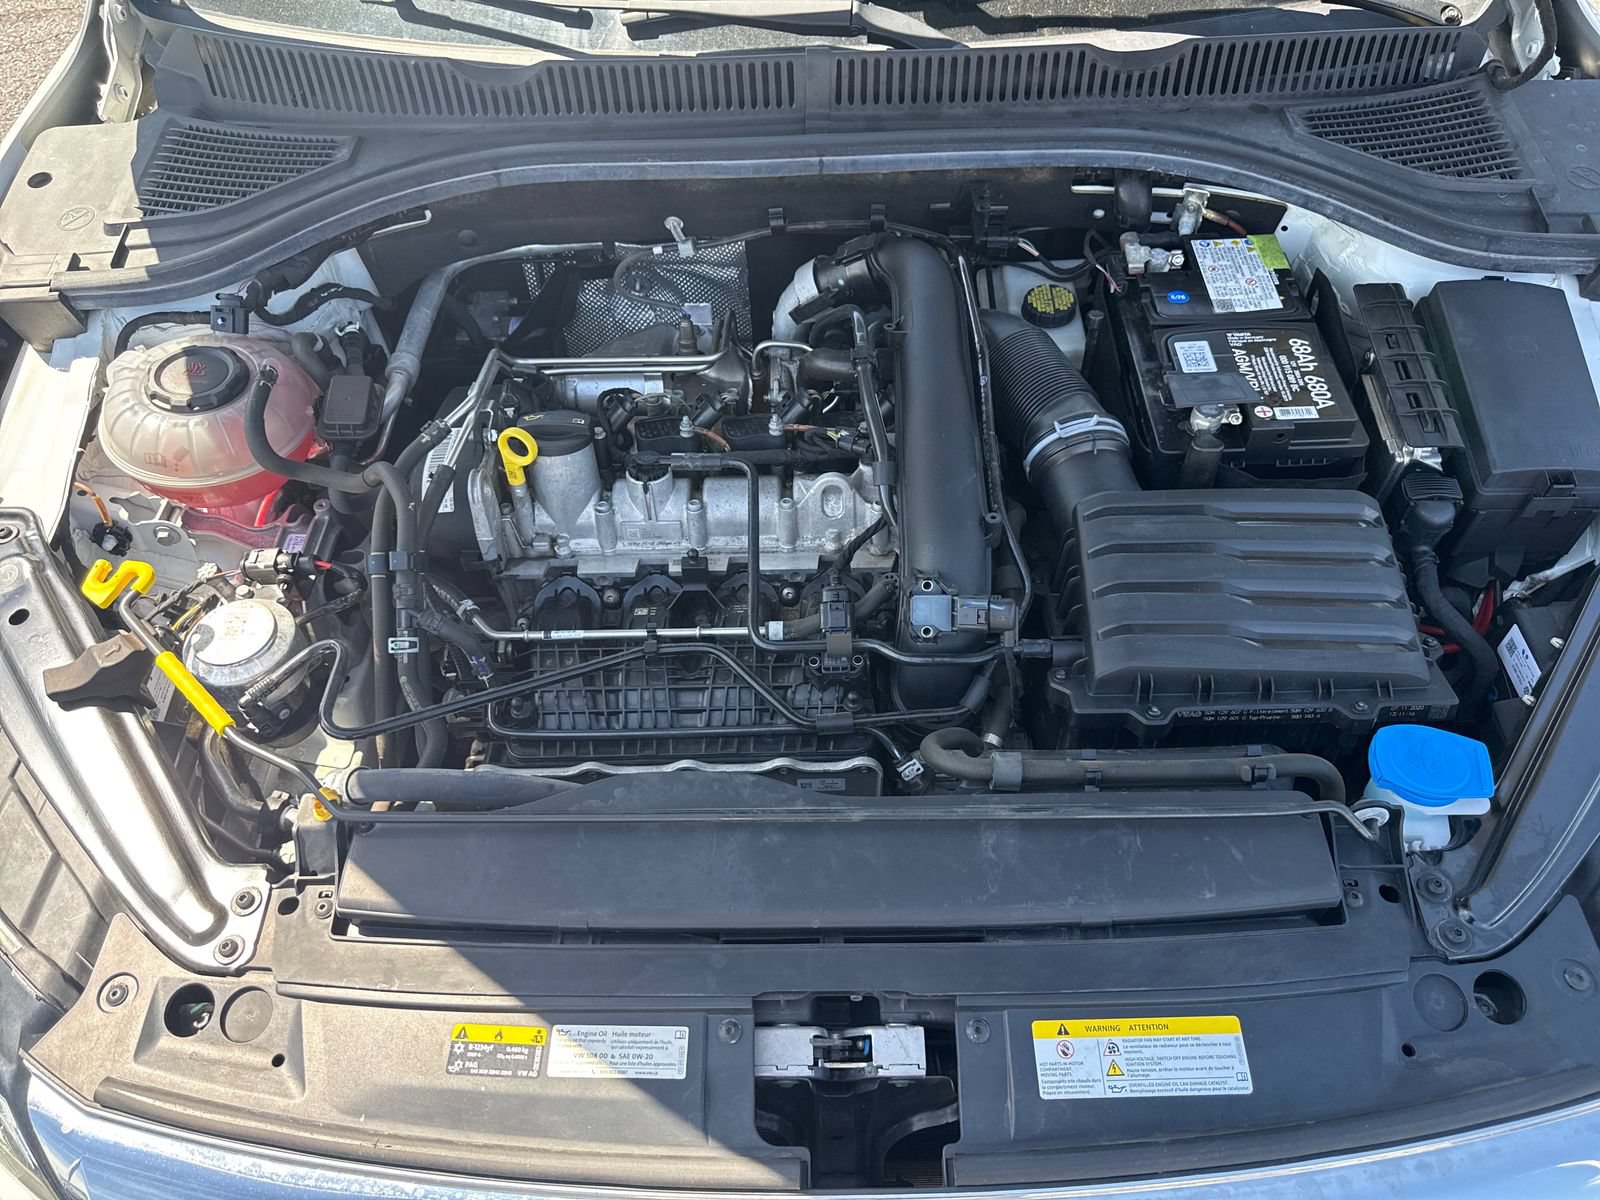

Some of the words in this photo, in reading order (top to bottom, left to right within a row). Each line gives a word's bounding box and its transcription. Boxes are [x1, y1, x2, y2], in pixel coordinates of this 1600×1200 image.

[1288, 338, 1318, 372] 68Ah
[1304, 375, 1335, 410] 680A
[1085, 1024, 1120, 1032] WARNING
[1128, 1023, 1169, 1032] ATTENTION
[578, 1030, 597, 1038] Engine
[528, 1070, 538, 1078] AG
